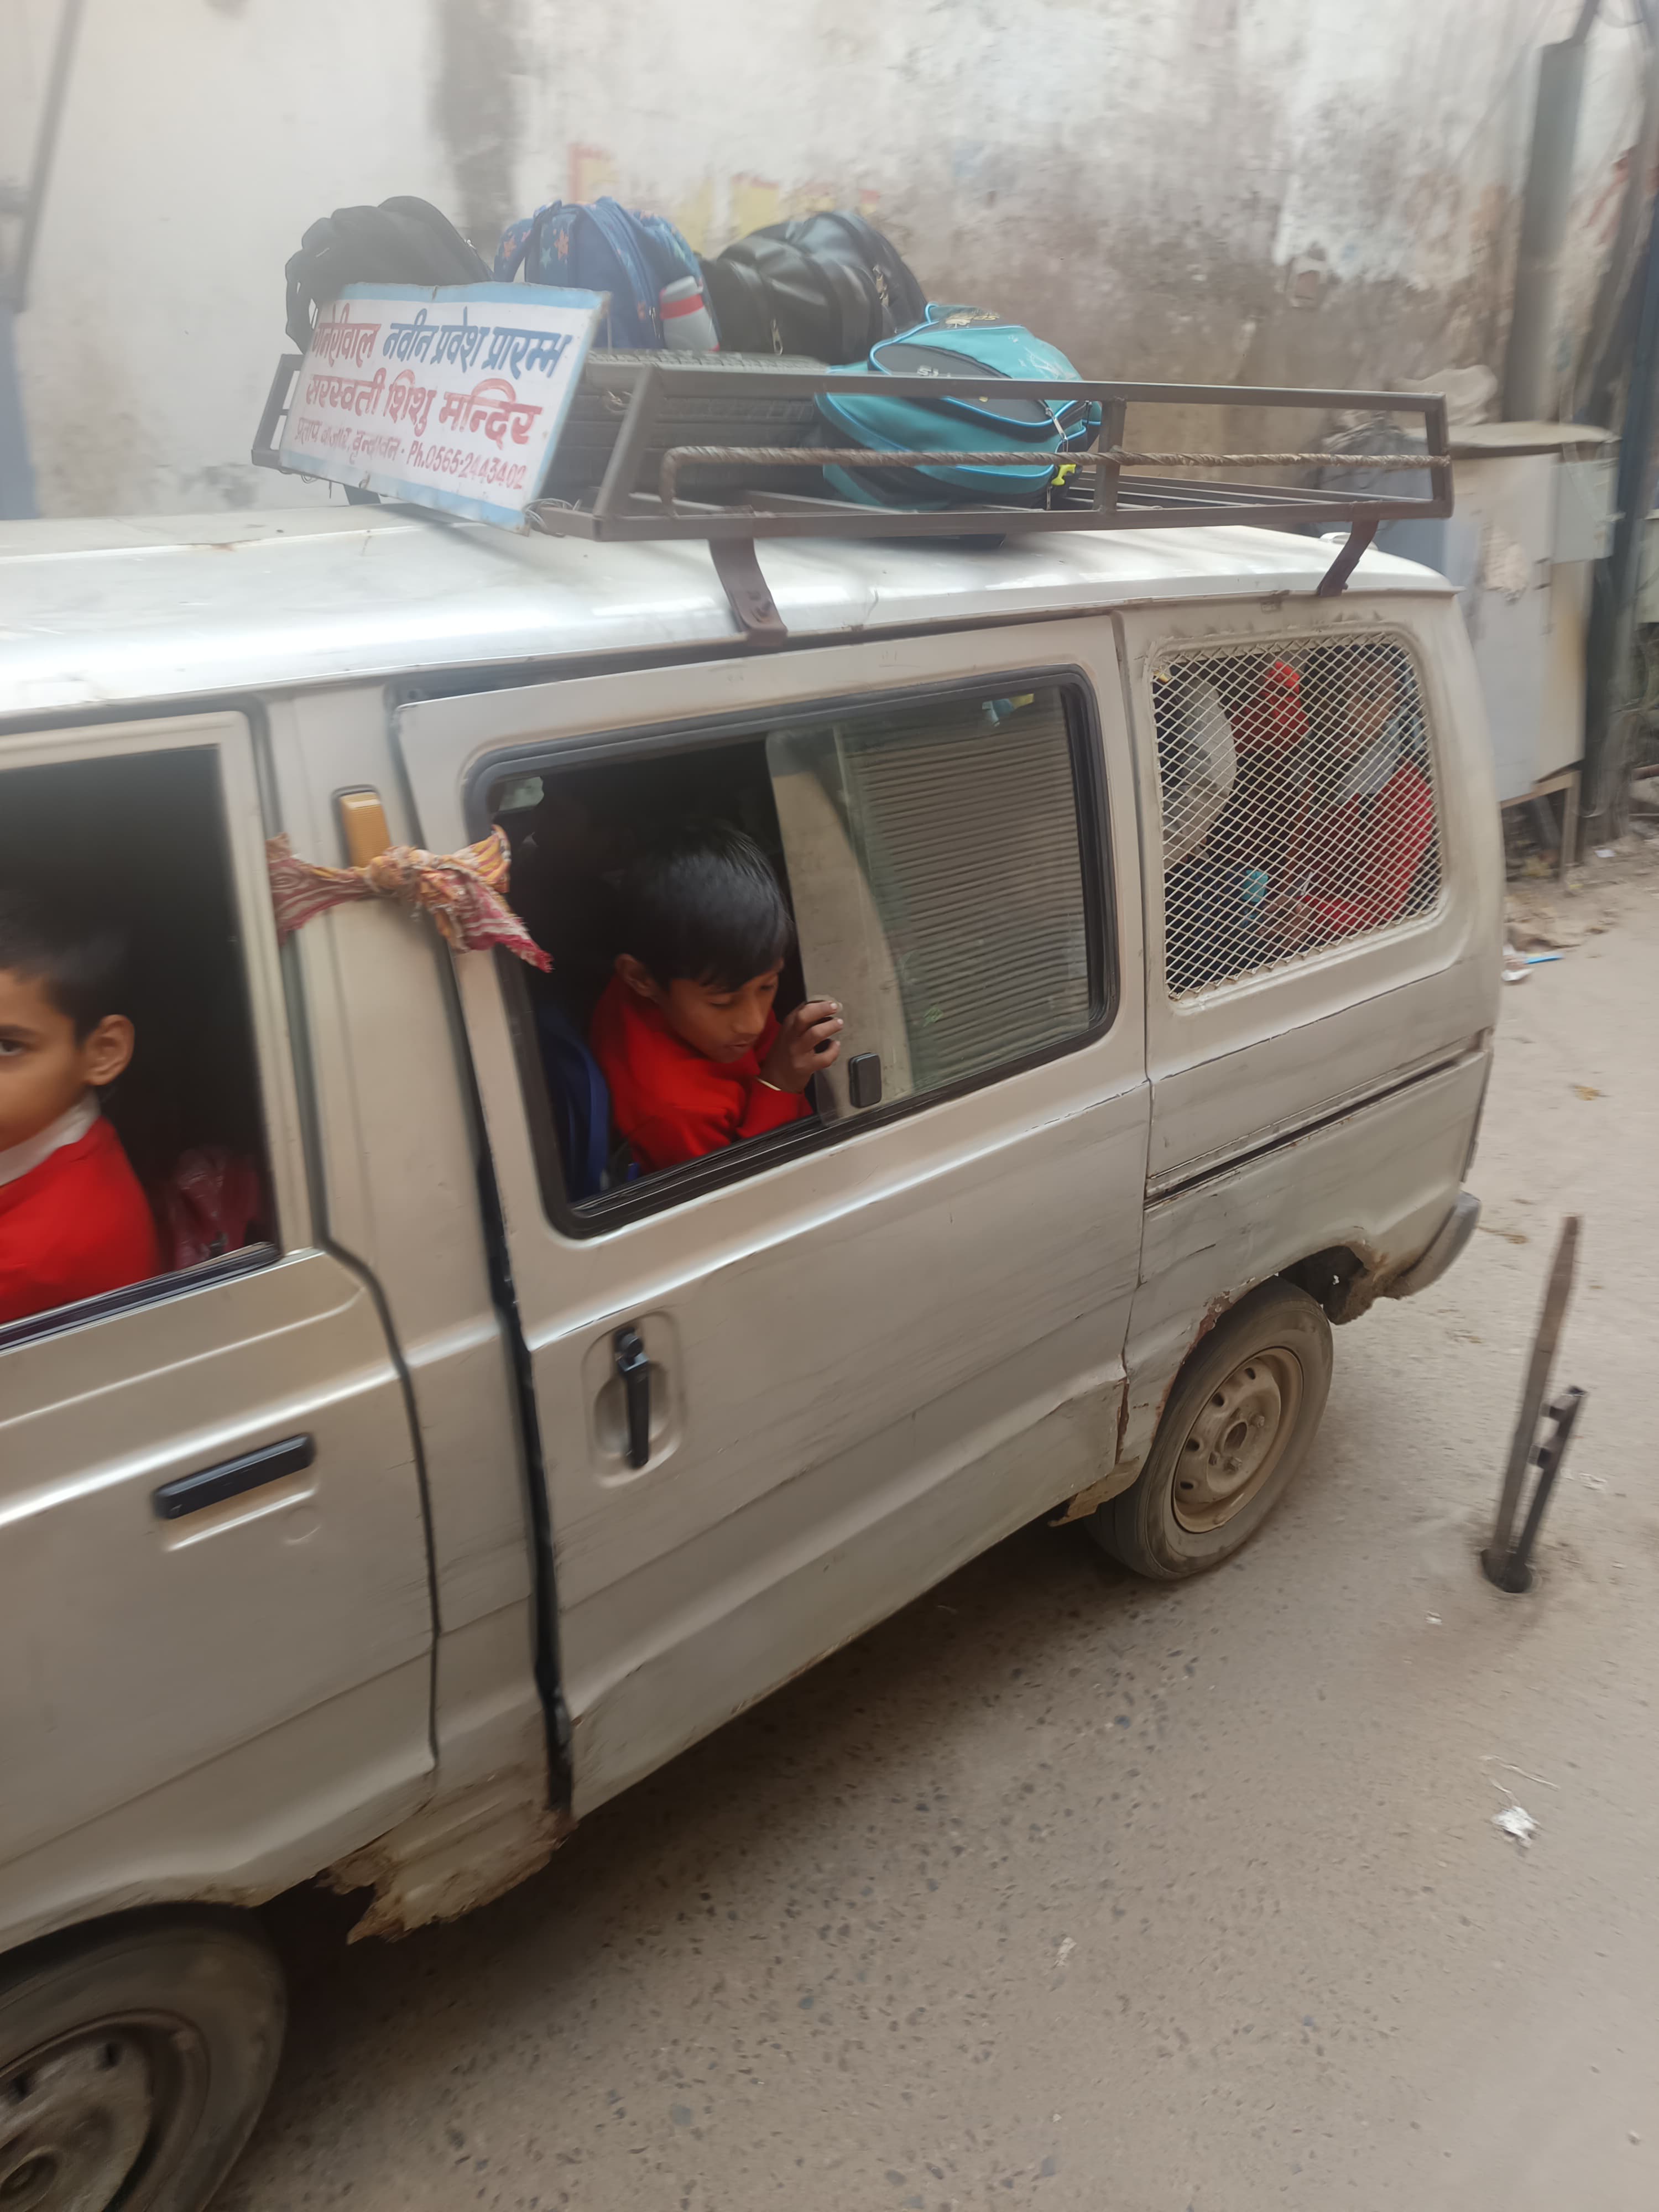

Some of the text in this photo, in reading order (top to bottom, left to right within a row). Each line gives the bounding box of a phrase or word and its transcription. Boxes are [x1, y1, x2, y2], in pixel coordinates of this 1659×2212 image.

[383, 308, 440, 363] नवीन
[430, 306, 491, 373] प्रवेश
[306, 367, 543, 450] सरस्वती शिशु मन्दिर
